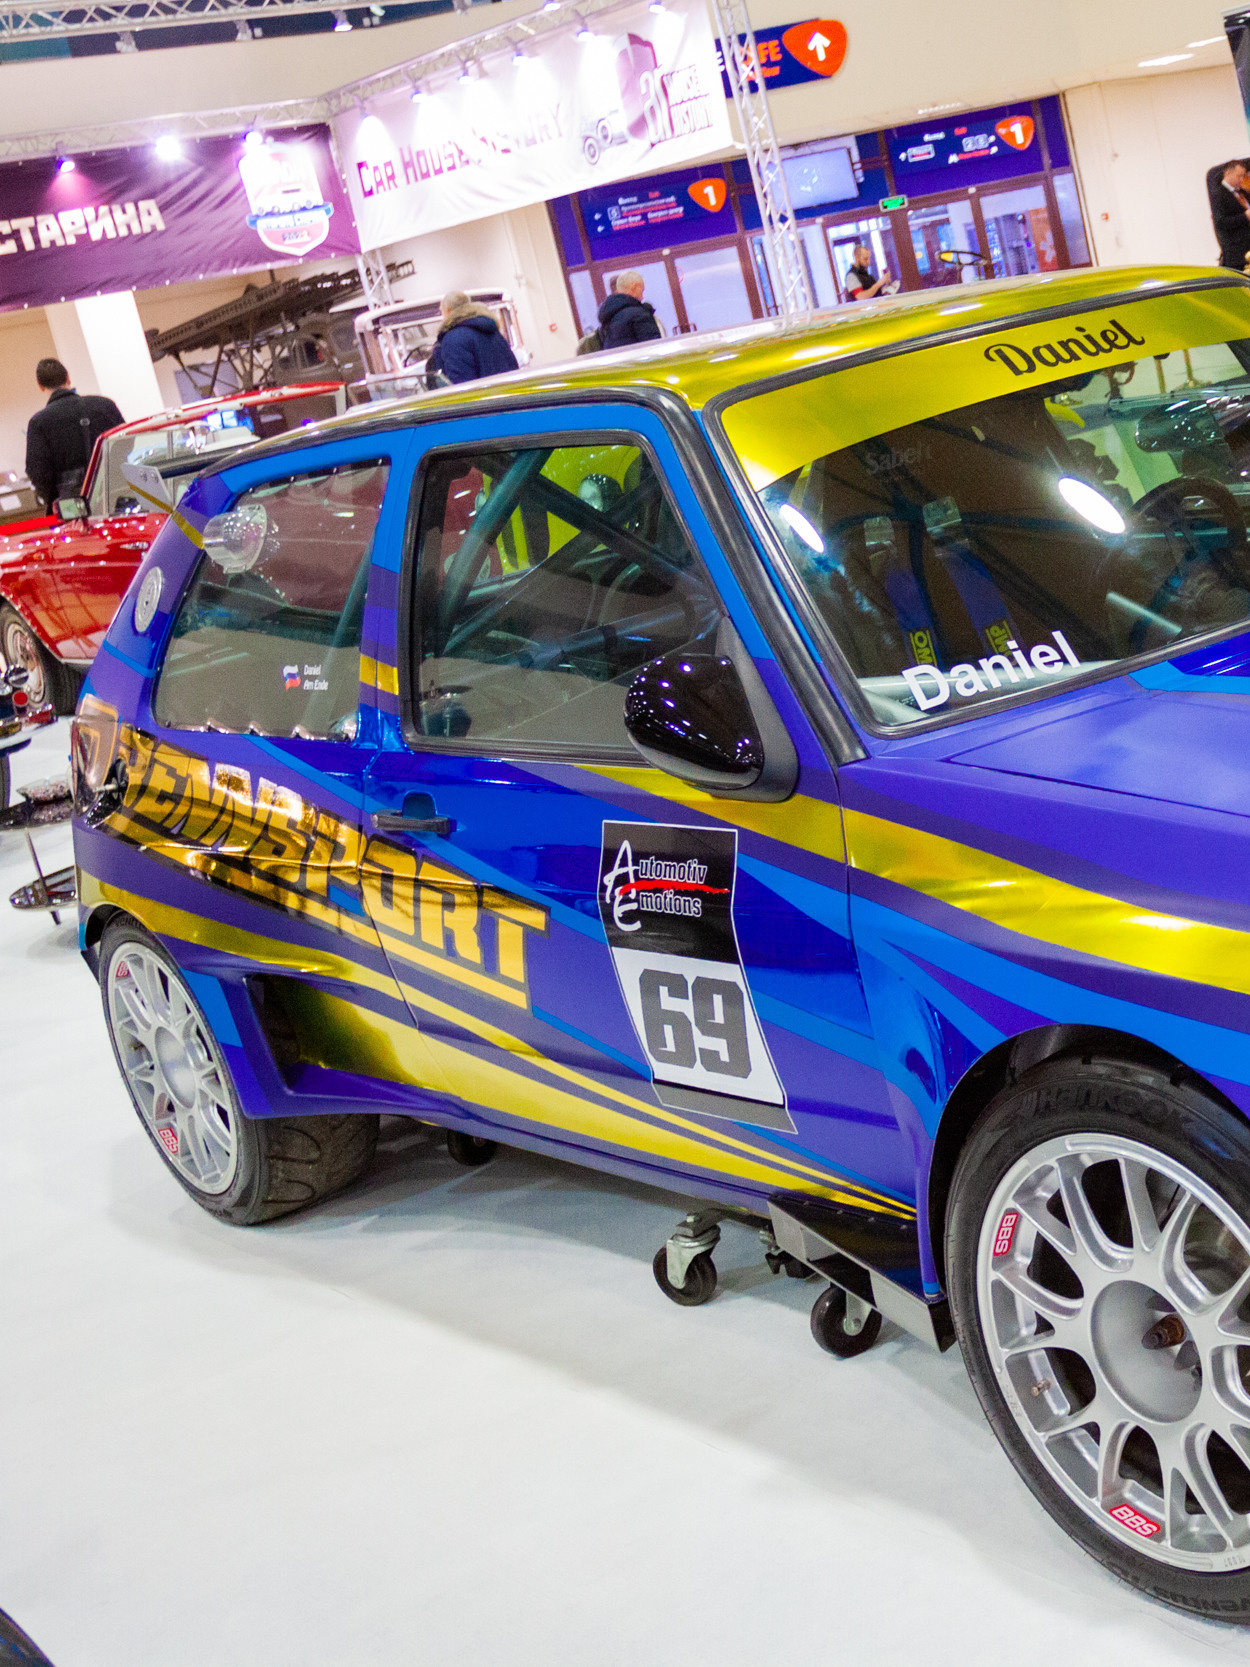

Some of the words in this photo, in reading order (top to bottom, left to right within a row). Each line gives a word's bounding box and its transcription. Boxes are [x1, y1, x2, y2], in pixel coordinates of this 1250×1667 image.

[1010, 122, 1025, 145] 1
[703, 185, 717, 206] 1
[984, 319, 1146, 376] Daniel
[303, 664, 322, 676] Daniel
[902, 630, 1081, 711] Daniel
[613, 886, 702, 931] Emotions
[639, 968, 752, 1080] 69
[160, 1128, 178, 1153] BBS
[995, 1214, 1018, 1254] BBS
[1111, 1505, 1158, 1537] BBS
